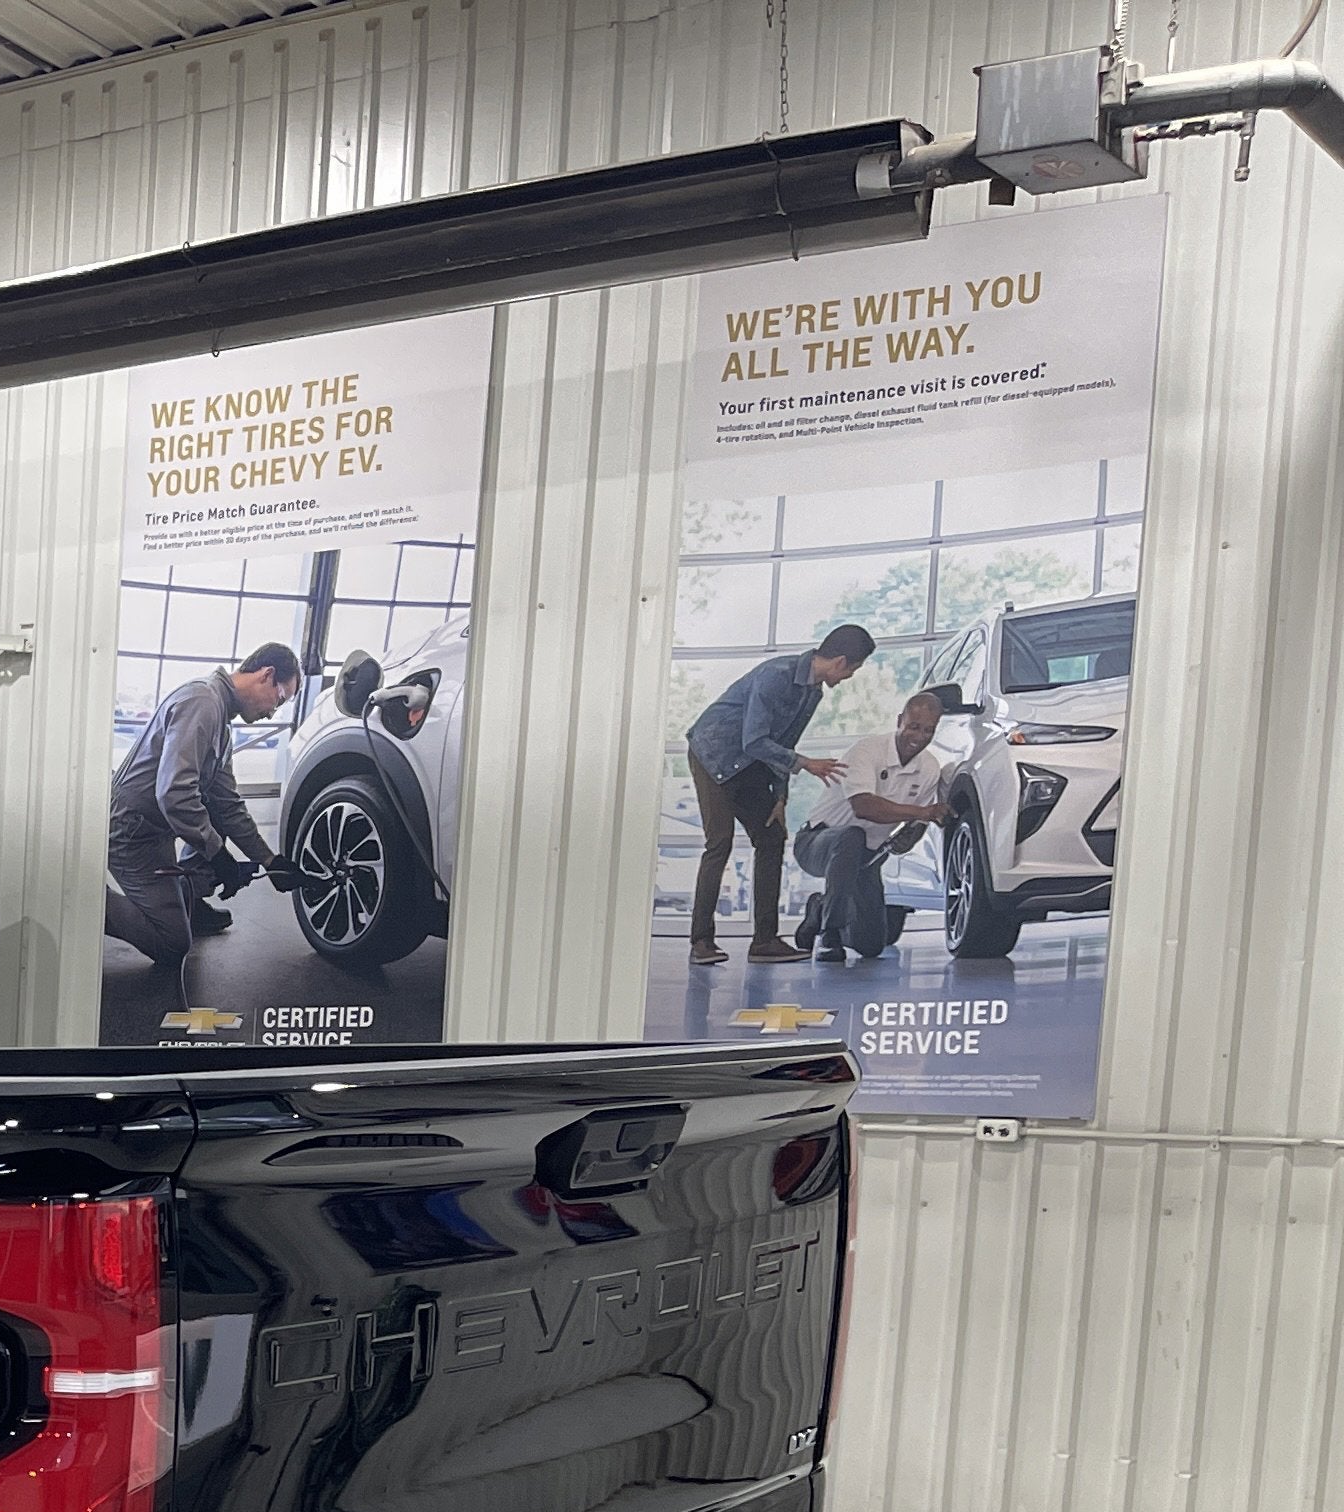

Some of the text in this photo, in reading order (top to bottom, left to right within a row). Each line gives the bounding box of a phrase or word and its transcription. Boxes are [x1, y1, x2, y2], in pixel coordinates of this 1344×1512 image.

[725, 271, 1043, 344] WE'RE WITH YOU
[721, 323, 976, 383] ALL THE WAY.
[151, 373, 360, 429] WE KNOW THE
[718, 401, 755, 416] Your
[759, 396, 795, 413] first
[799, 383, 906, 408] maintenance
[910, 377, 947, 395] visit
[951, 375, 966, 390] is
[755, 421, 766, 430] oil
[767, 420, 783, 429] and
[784, 419, 795, 427] oil
[796, 416, 817, 426] filter
[819, 413, 853, 424] change,
[854, 409, 880, 420] diesel
[881, 404, 915, 417] exhaust
[917, 402, 937, 412] fluid
[939, 399, 959, 409] tank
[960, 396, 982, 407] refill
[983, 394, 1001, 405] (for
[1002, 384, 1075, 402] diesel-equipped
[149, 405, 394, 464] RIGHT TIRES FOR
[716, 416, 924, 444] 4-tire rotation, and Multi-Point Vehicle Inspection.
[147, 444, 383, 499] YOUR CHEVY EV.
[145, 499, 320, 526] Tire Price Match Guarantee.
[178, 530, 193, 538] with
[200, 528, 221, 536] better
[247, 524, 265, 533] price
[274, 521, 286, 529] the
[287, 519, 303, 527] time
[304, 517, 312, 526] of
[348, 512, 362, 520] and
[381, 507, 403, 516] match
[143, 543, 157, 551] Find
[164, 541, 184, 549] better
[185, 540, 202, 549] price
[203, 537, 224, 546] within
[235, 535, 251, 544] days
[252, 533, 260, 541] of
[261, 532, 272, 541] the
[309, 527, 322, 535] and
[340, 523, 364, 531] refund
[365, 519, 378, 528] the
[263, 1006, 374, 1029] CERTIFIED
[863, 999, 1009, 1027] CERTIFIED
[262, 1031, 353, 1047] SERVICE
[860, 1029, 981, 1055] SERVICE
[260, 1231, 820, 1402] CHEVROLET
[789, 1427, 818, 1455] LTZ
